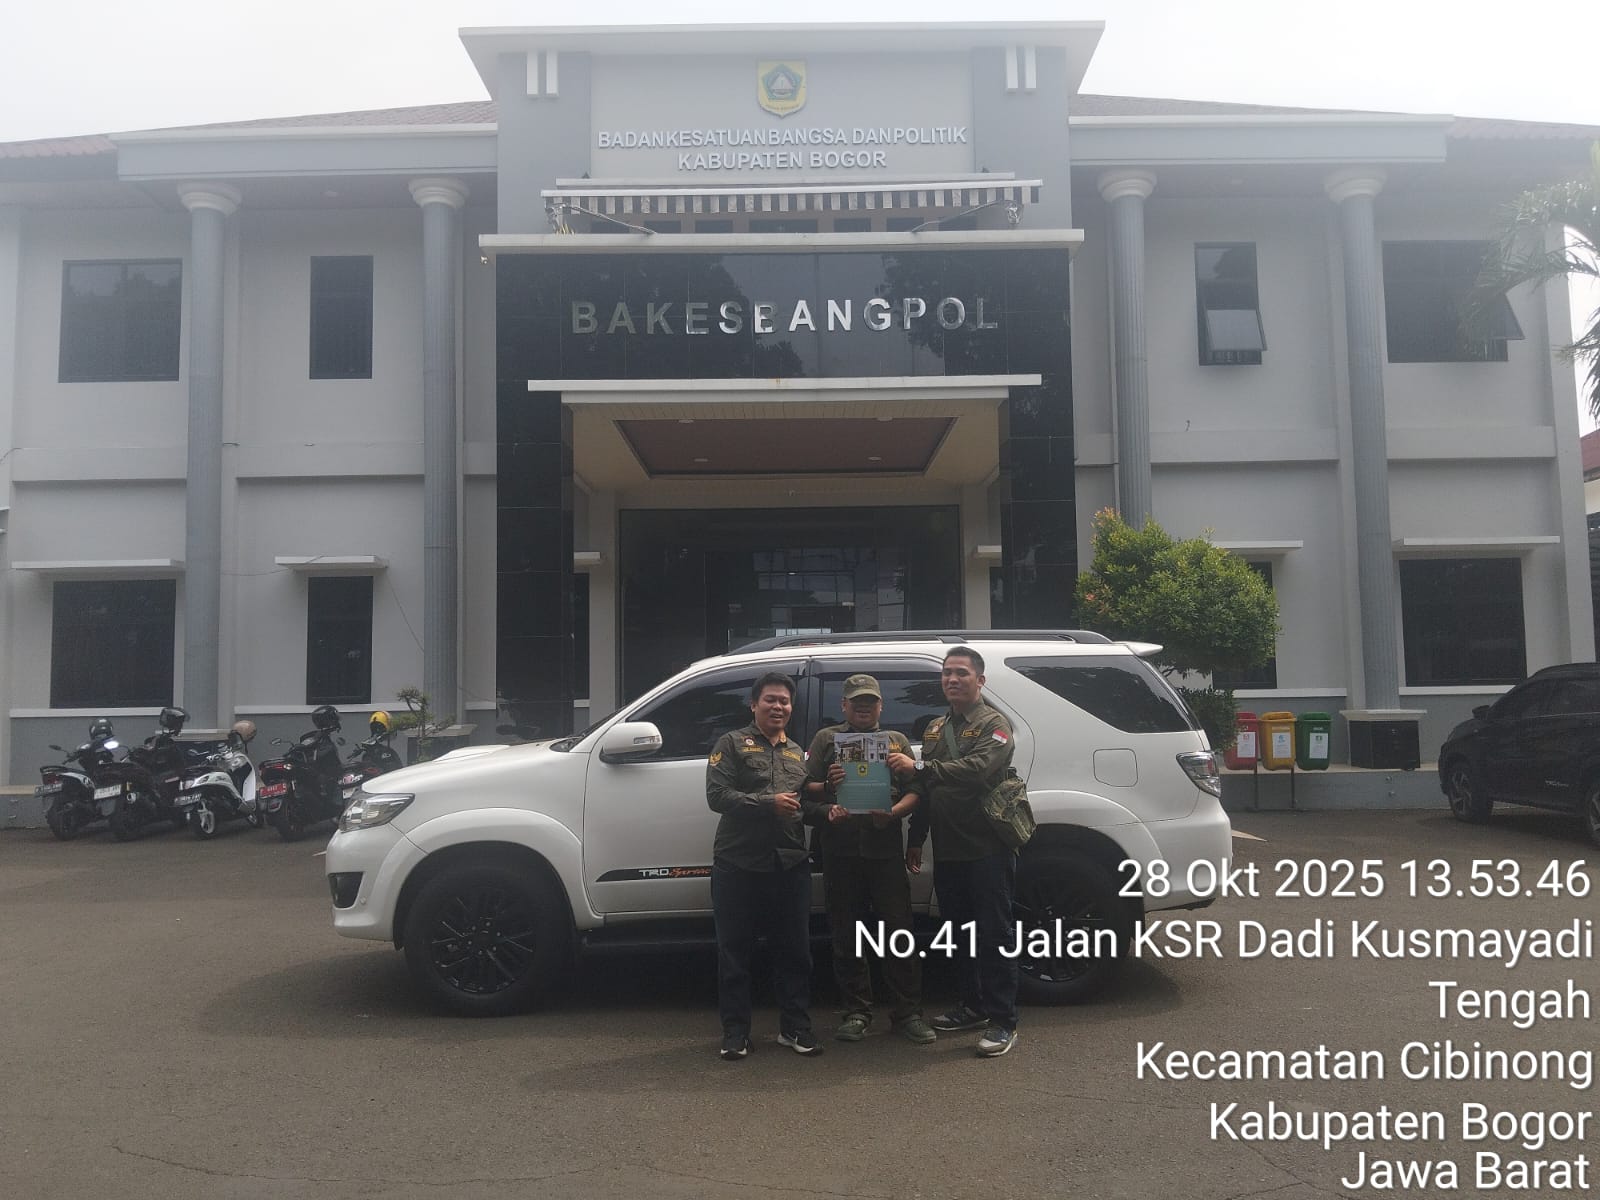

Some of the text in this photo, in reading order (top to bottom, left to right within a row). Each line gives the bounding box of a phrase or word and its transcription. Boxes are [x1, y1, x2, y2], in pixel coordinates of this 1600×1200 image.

[678, 151, 887, 170] KABUPATEN BOGOR
[572, 297, 998, 335] BAKESBANGPOL
[639, 868, 669, 876] TRD
